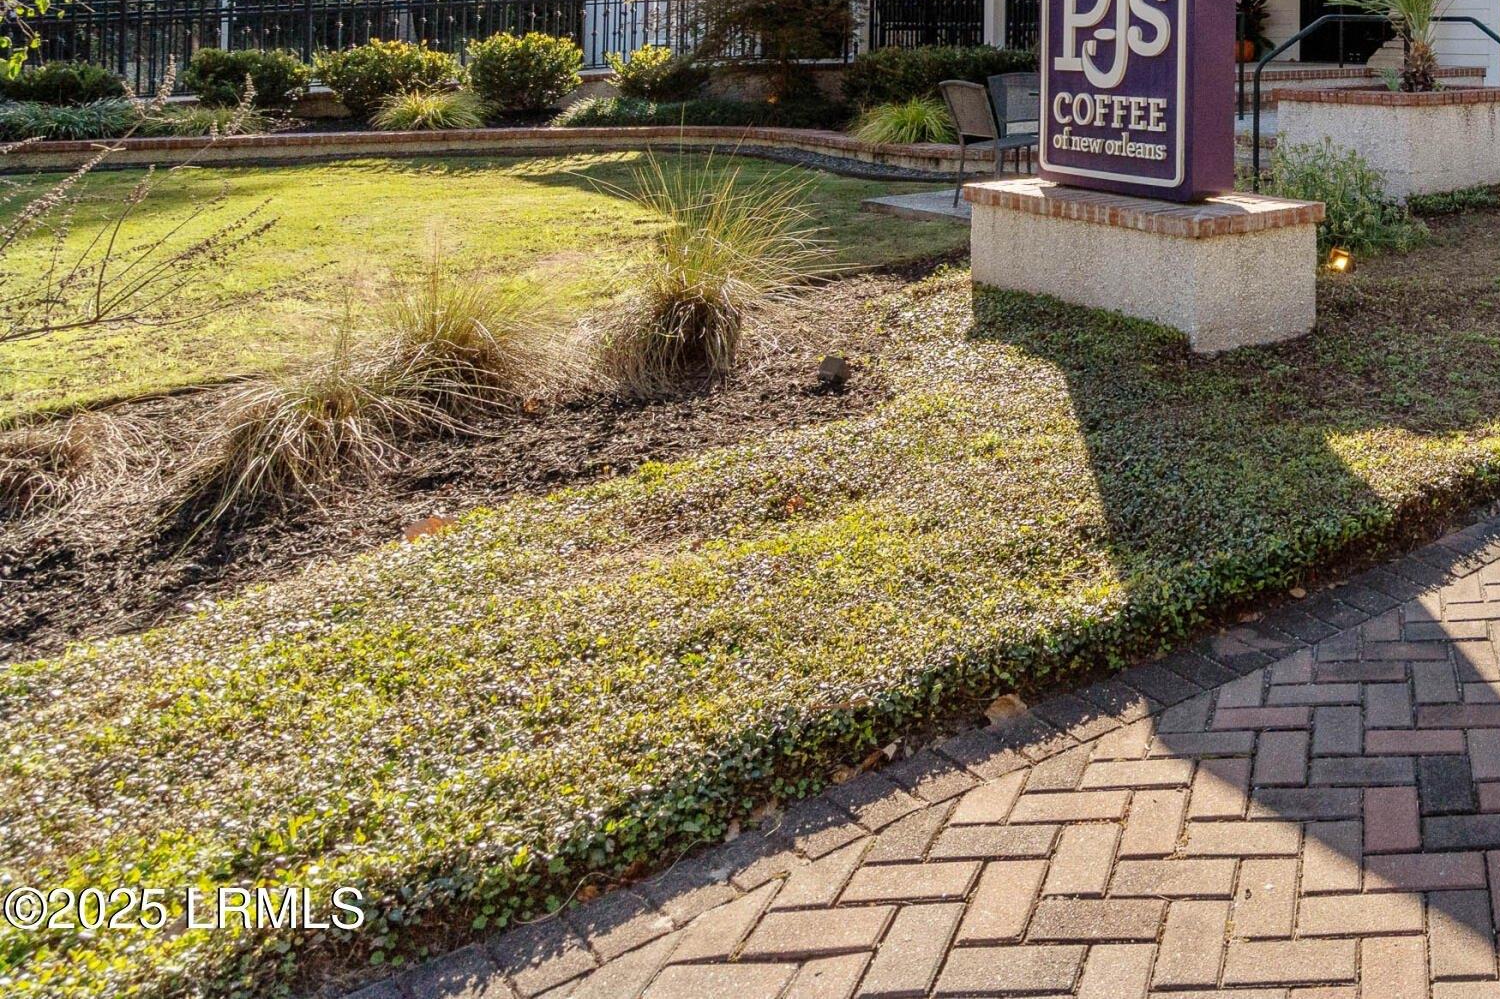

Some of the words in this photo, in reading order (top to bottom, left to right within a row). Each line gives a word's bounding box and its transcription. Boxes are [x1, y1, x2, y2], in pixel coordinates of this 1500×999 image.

[1053, 92, 1168, 131] COFFEE
[1053, 126, 1072, 150] of
[1071, 136, 1105, 154] new
[1105, 132, 1168, 160] orleans
